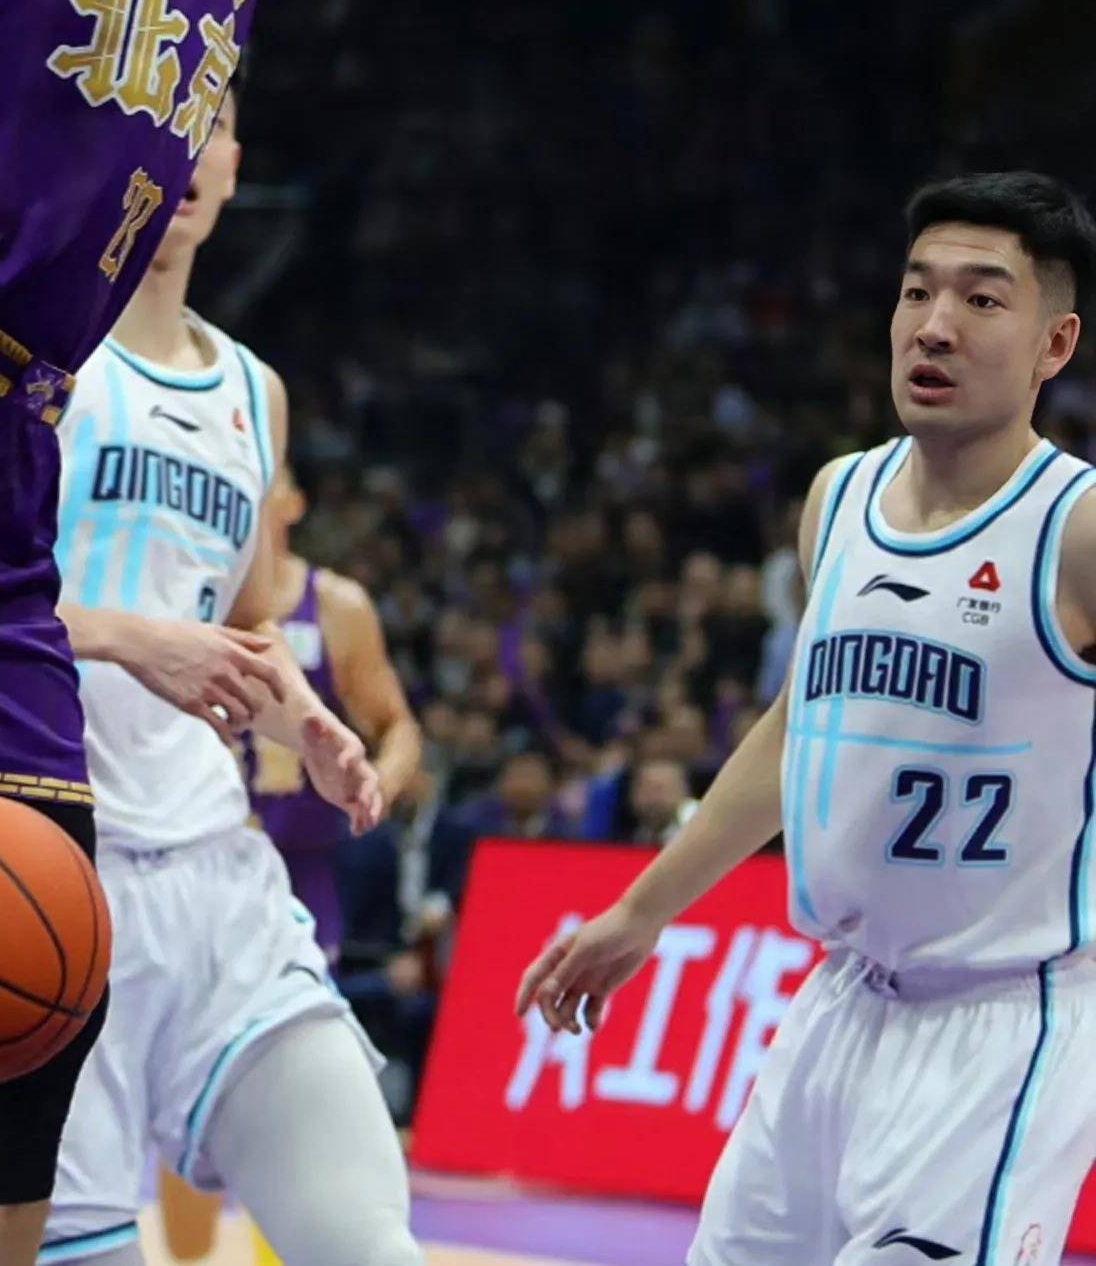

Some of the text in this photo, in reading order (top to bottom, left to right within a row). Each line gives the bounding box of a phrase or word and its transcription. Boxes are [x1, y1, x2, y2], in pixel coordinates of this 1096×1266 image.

[91, 446, 254, 551] QINGDAO
[961, 612, 990, 626] CGB
[805, 632, 985, 724] QINGDAO
[889, 767, 1016, 862] 22
